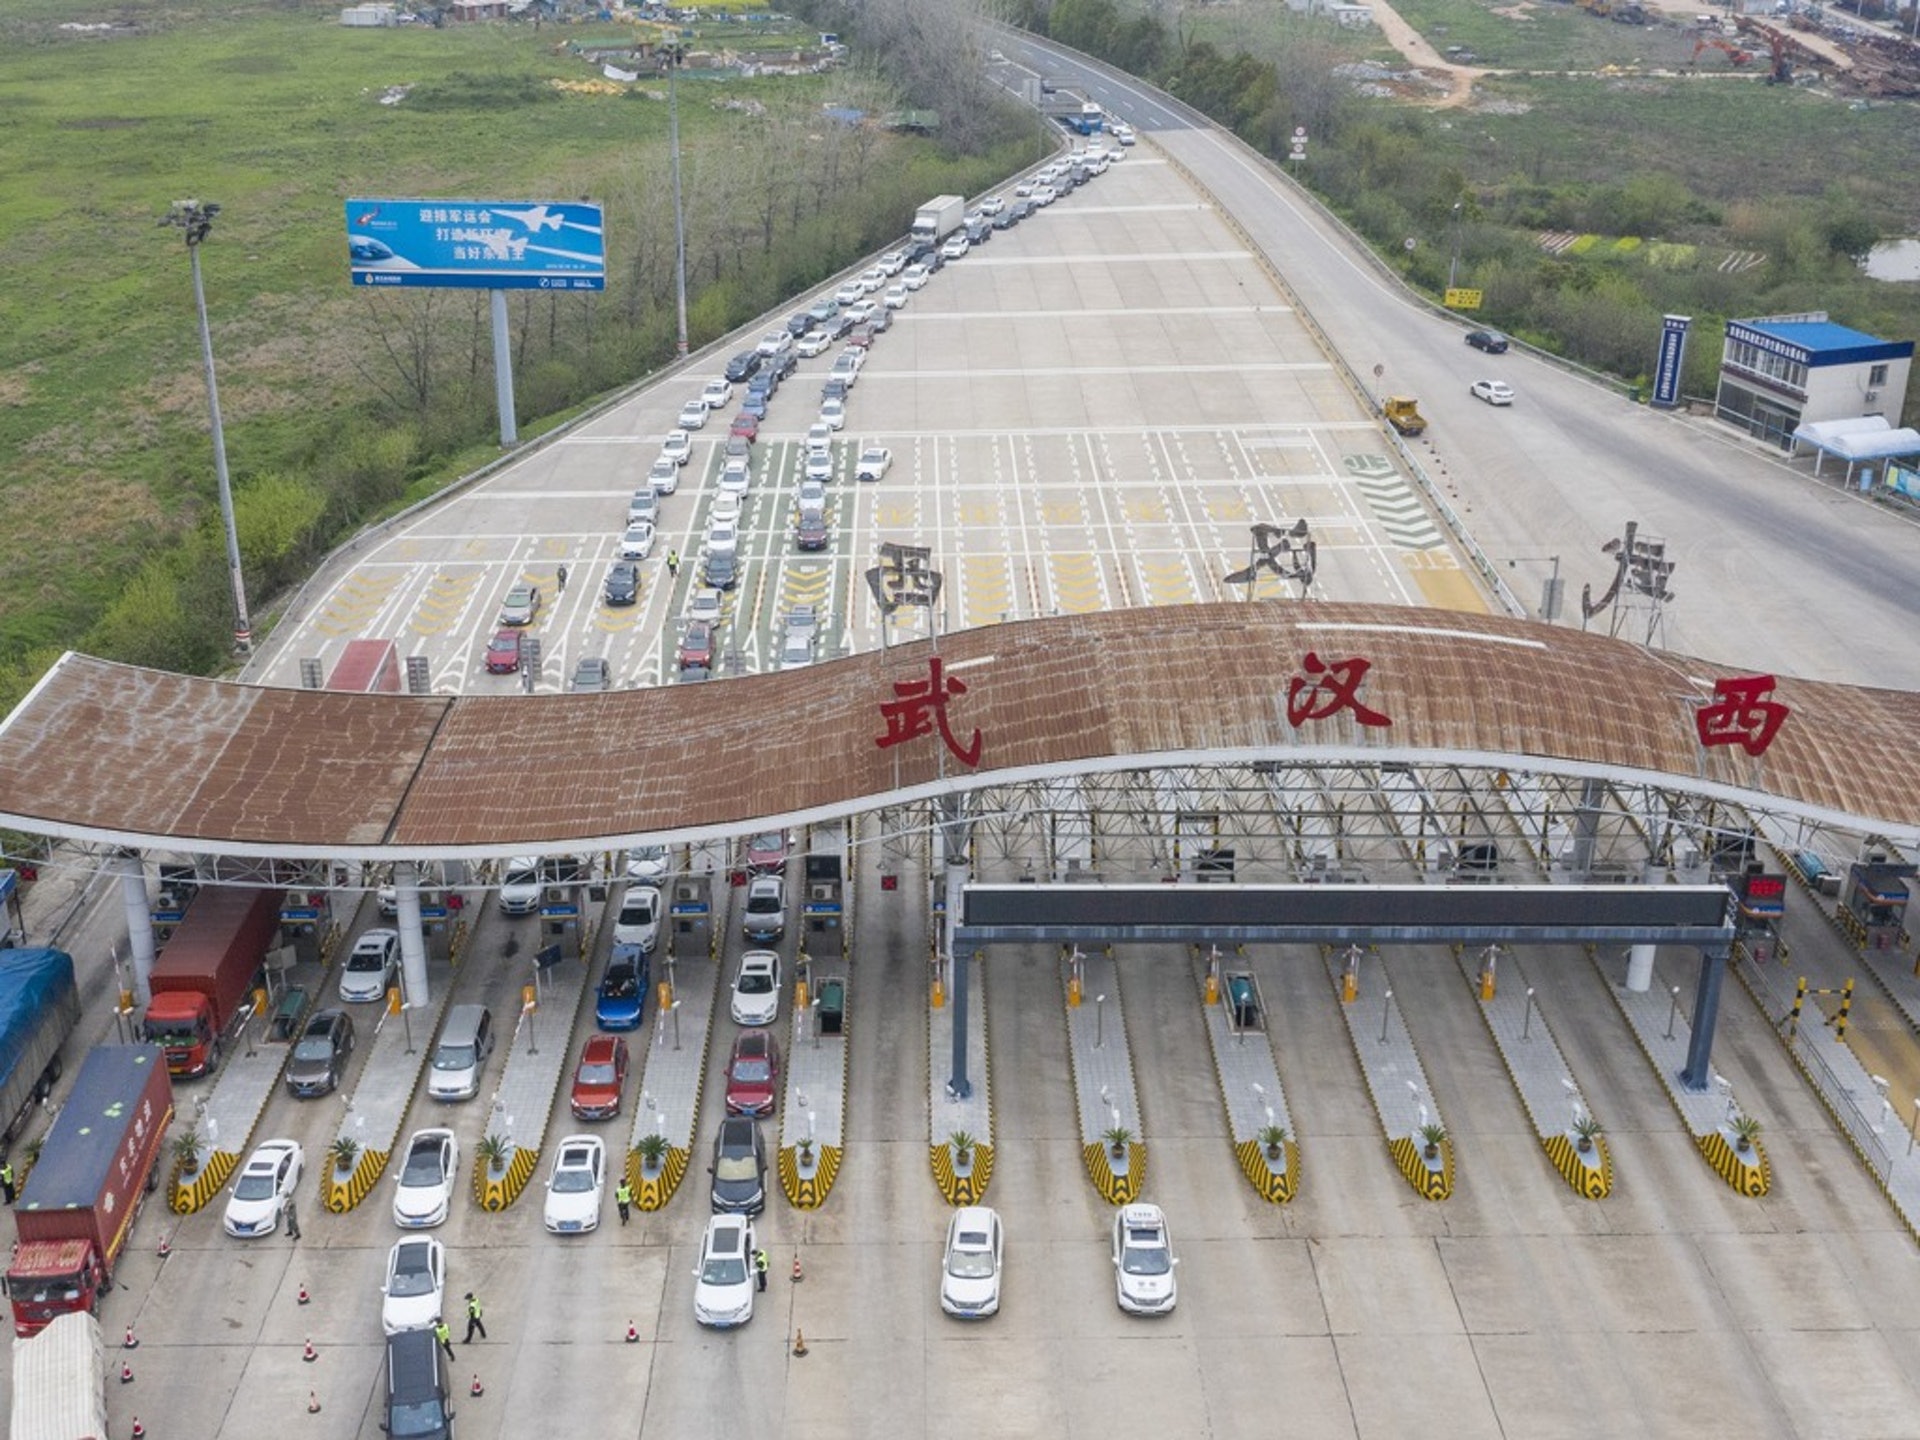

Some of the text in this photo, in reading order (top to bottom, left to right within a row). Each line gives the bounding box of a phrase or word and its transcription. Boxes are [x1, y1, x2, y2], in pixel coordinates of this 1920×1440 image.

[419, 208, 492, 224] 迎接军运会
[1402, 551, 1460, 569] ETC
